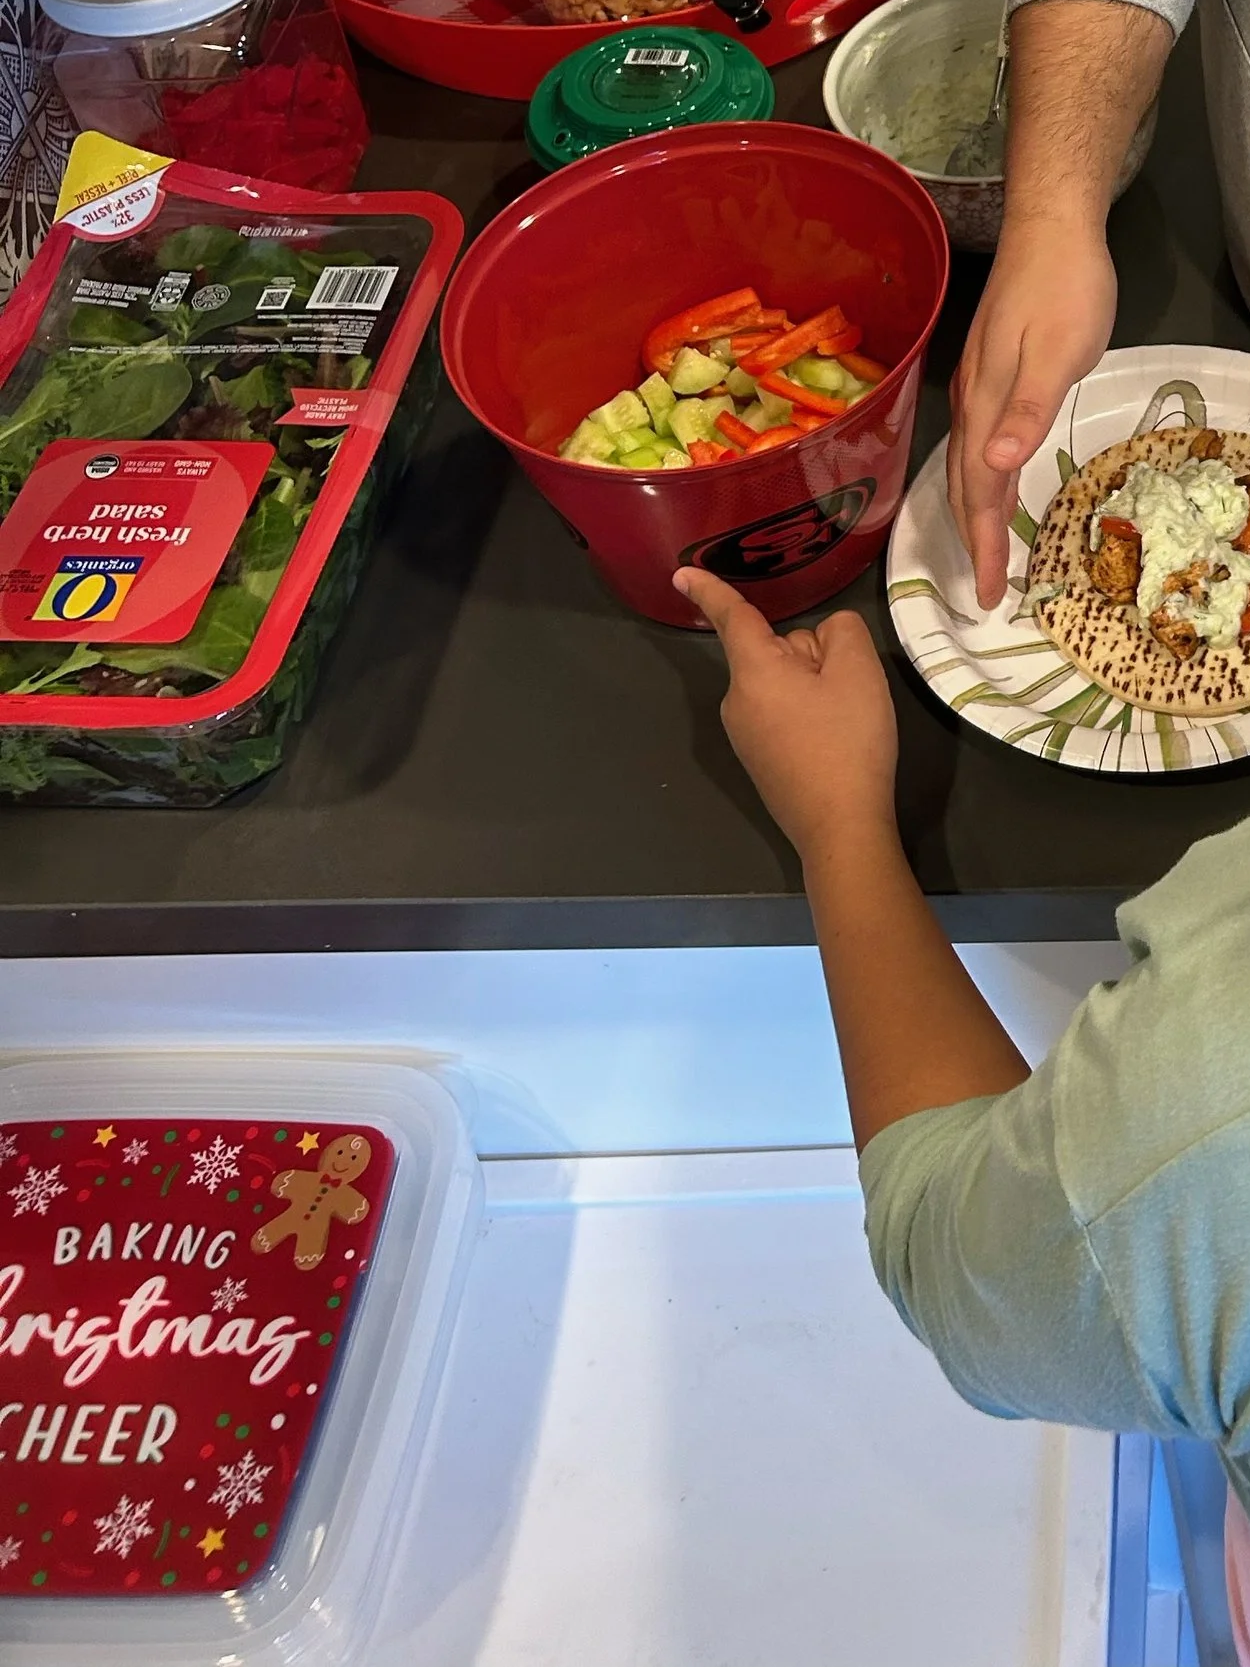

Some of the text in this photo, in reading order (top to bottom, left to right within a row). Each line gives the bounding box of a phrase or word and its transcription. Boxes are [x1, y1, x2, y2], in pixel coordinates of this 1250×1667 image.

[115, 169, 139, 186] PEEL
[74, 183, 108, 205] RESEAL
[125, 186, 151, 205] LESS
[112, 210, 135, 228] 32%
[316, 397, 349, 405] PLASTIC
[173, 459, 212, 468] NON-GMO
[175, 467, 208, 476] ALWAYS
[89, 504, 168, 521] salad
[43, 525, 192, 546] fresh herb
[65, 557, 136, 571] organics
[53, 1222, 236, 1270] BAKING
